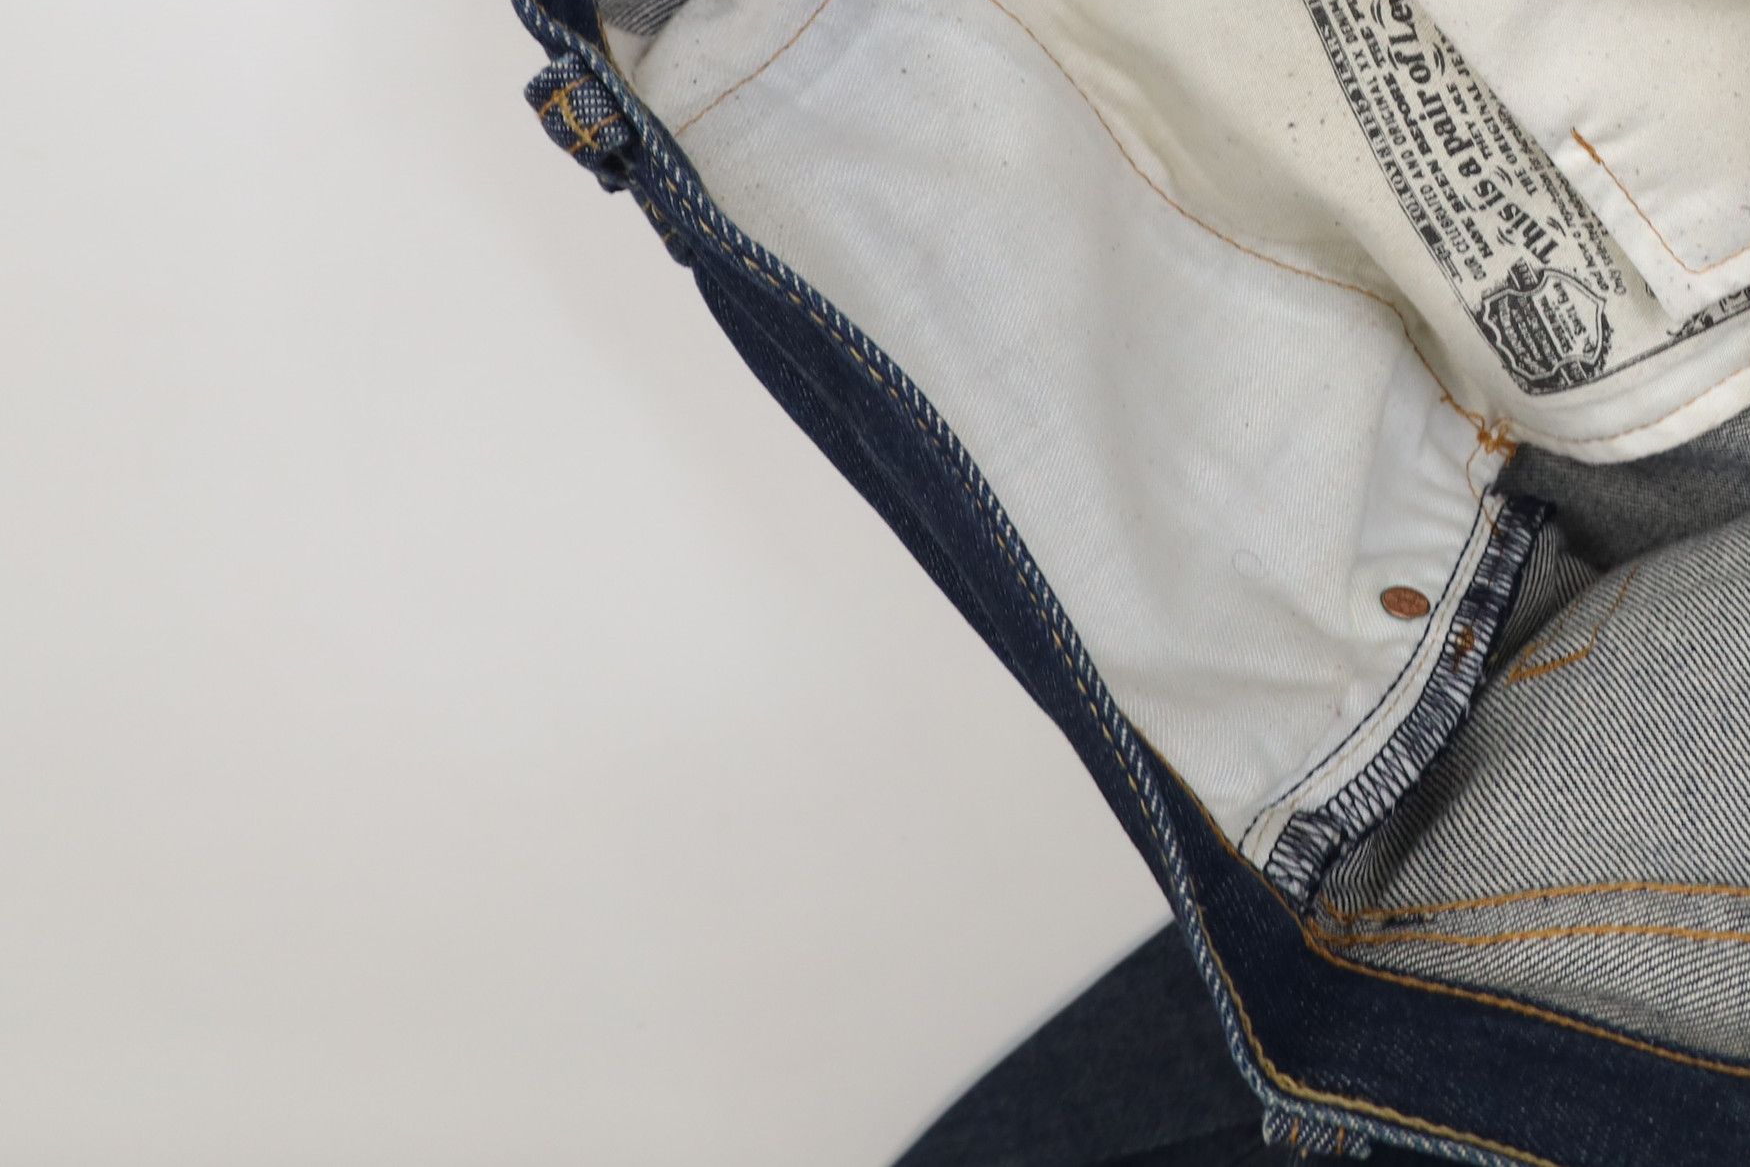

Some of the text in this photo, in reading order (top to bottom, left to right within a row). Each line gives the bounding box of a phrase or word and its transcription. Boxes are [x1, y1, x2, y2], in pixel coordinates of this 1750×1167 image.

[1359, 24, 1387, 68] THE
[1393, 51, 1432, 86] of
[1364, 75, 1407, 147] ORIGINAL
[1382, 71, 1432, 156] BEFORE
[1415, 88, 1474, 158] pair
[1445, 80, 1493, 160] THEY ARE
[1464, 80, 1518, 166] ORIGINAL
[1399, 147, 1426, 181] AND
[1426, 158, 1465, 213] BEEN
[1455, 154, 1483, 181] a
[1513, 166, 1538, 196] THE
[1472, 175, 1505, 211] is
[1417, 181, 1471, 255] CELEBRATED
[1461, 215, 1493, 259] HAVE
[1498, 200, 1558, 266] This
[1462, 254, 1487, 281] OUR
